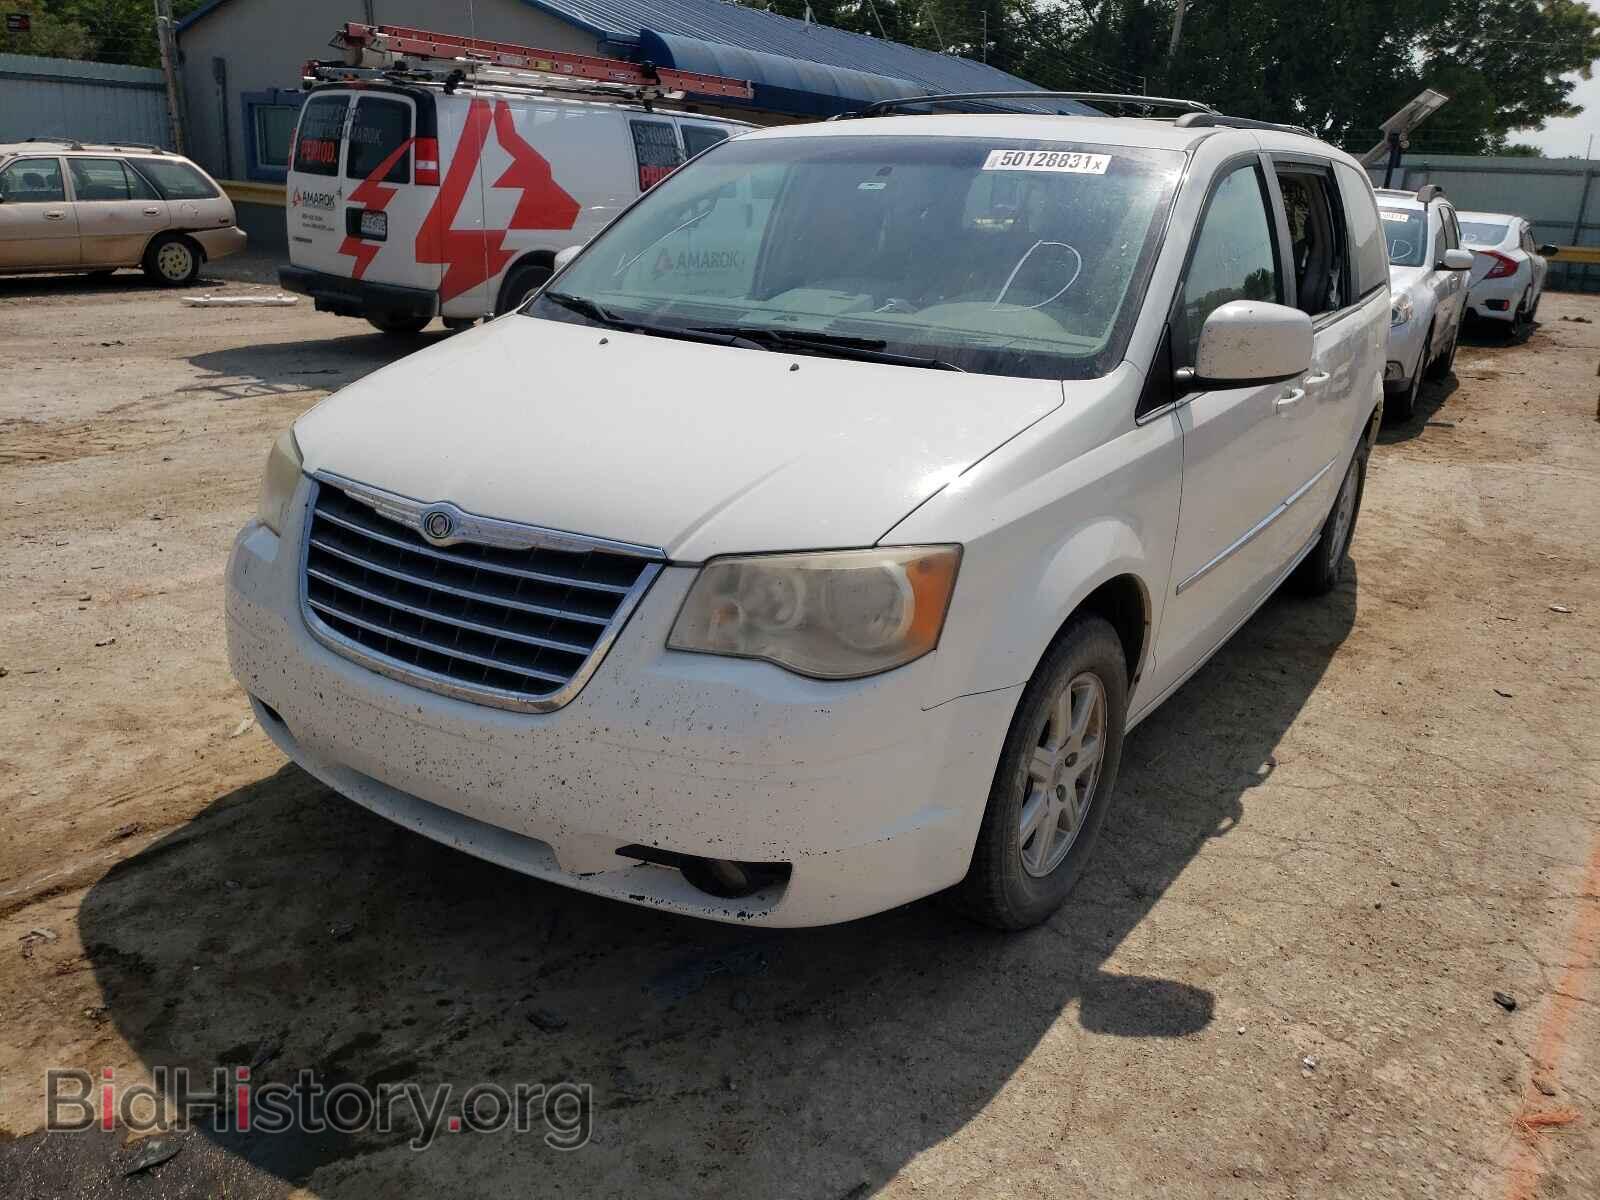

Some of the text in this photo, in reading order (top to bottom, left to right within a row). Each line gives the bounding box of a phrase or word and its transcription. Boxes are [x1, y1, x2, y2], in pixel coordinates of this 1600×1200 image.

[1000, 152, 1092, 169] 50128831
[302, 191, 335, 208] AMAROK
[676, 249, 739, 270] AMAROK
